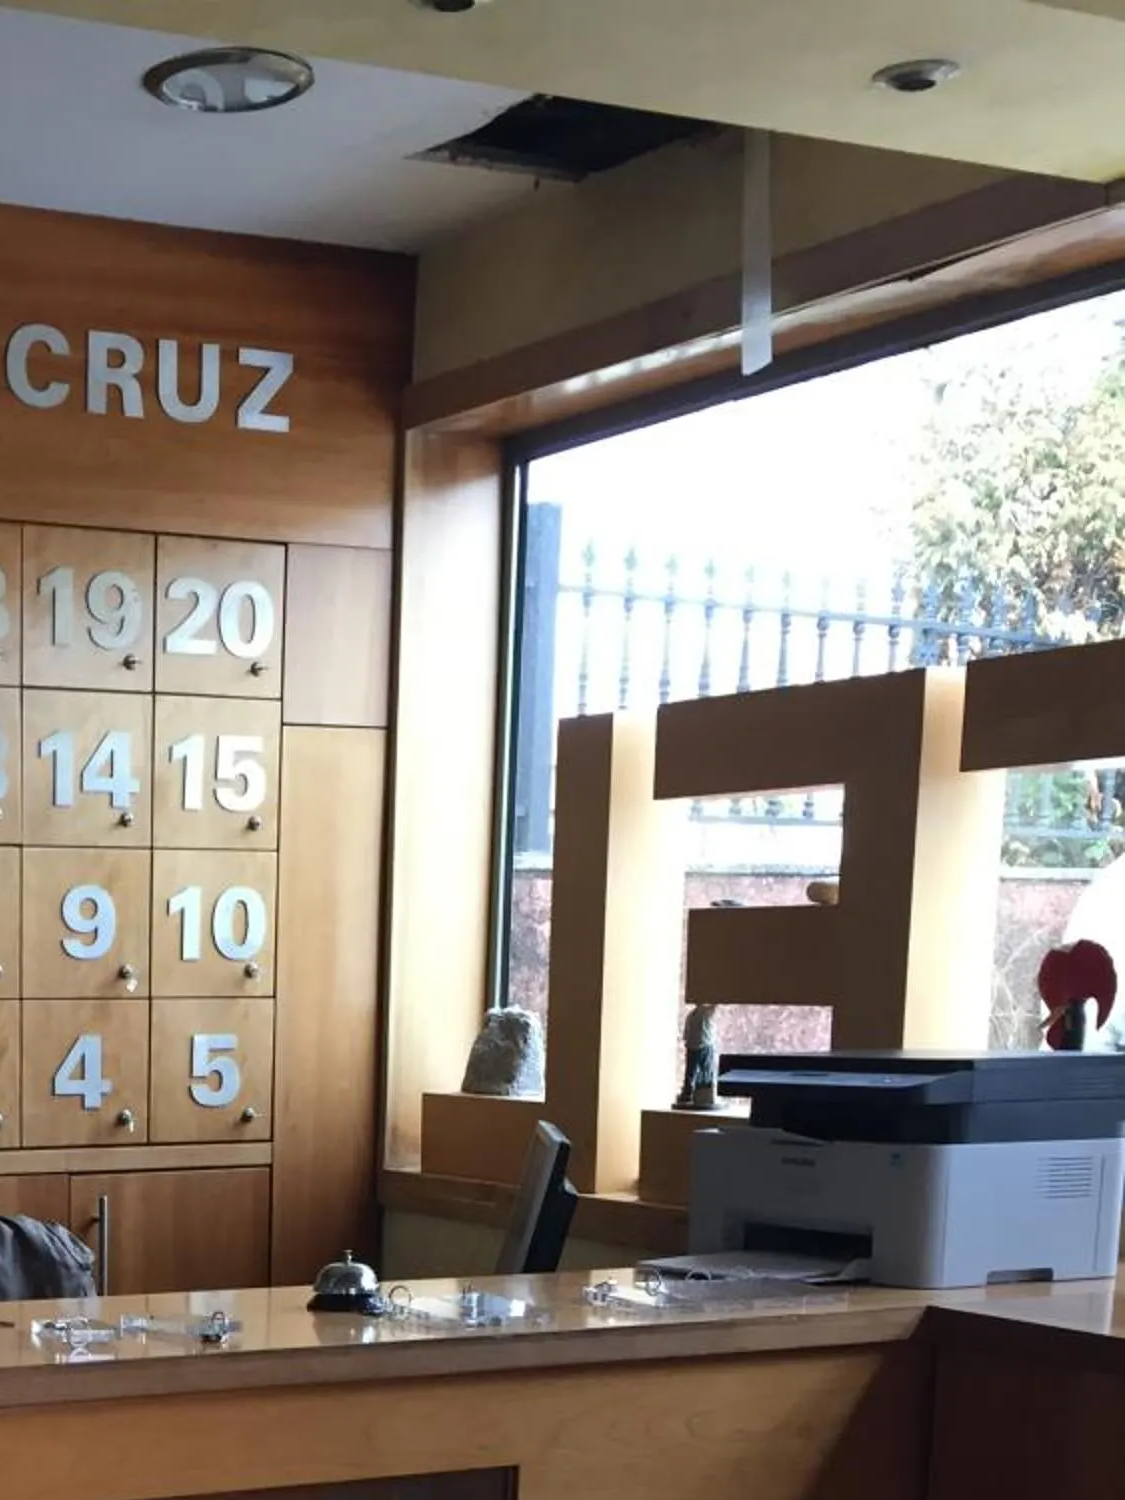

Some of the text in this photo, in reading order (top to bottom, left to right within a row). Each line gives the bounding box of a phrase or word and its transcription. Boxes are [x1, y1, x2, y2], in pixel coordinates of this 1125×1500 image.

[5, 324, 294, 433] CRUZ
[37, 566, 144, 650] 19
[164, 577, 275, 659] 20
[39, 729, 140, 808] 14
[168, 733, 267, 812] 15
[60, 884, 117, 960] 9
[167, 886, 267, 961] 10
[52, 1034, 112, 1111] 4
[188, 1034, 241, 1108] 5
